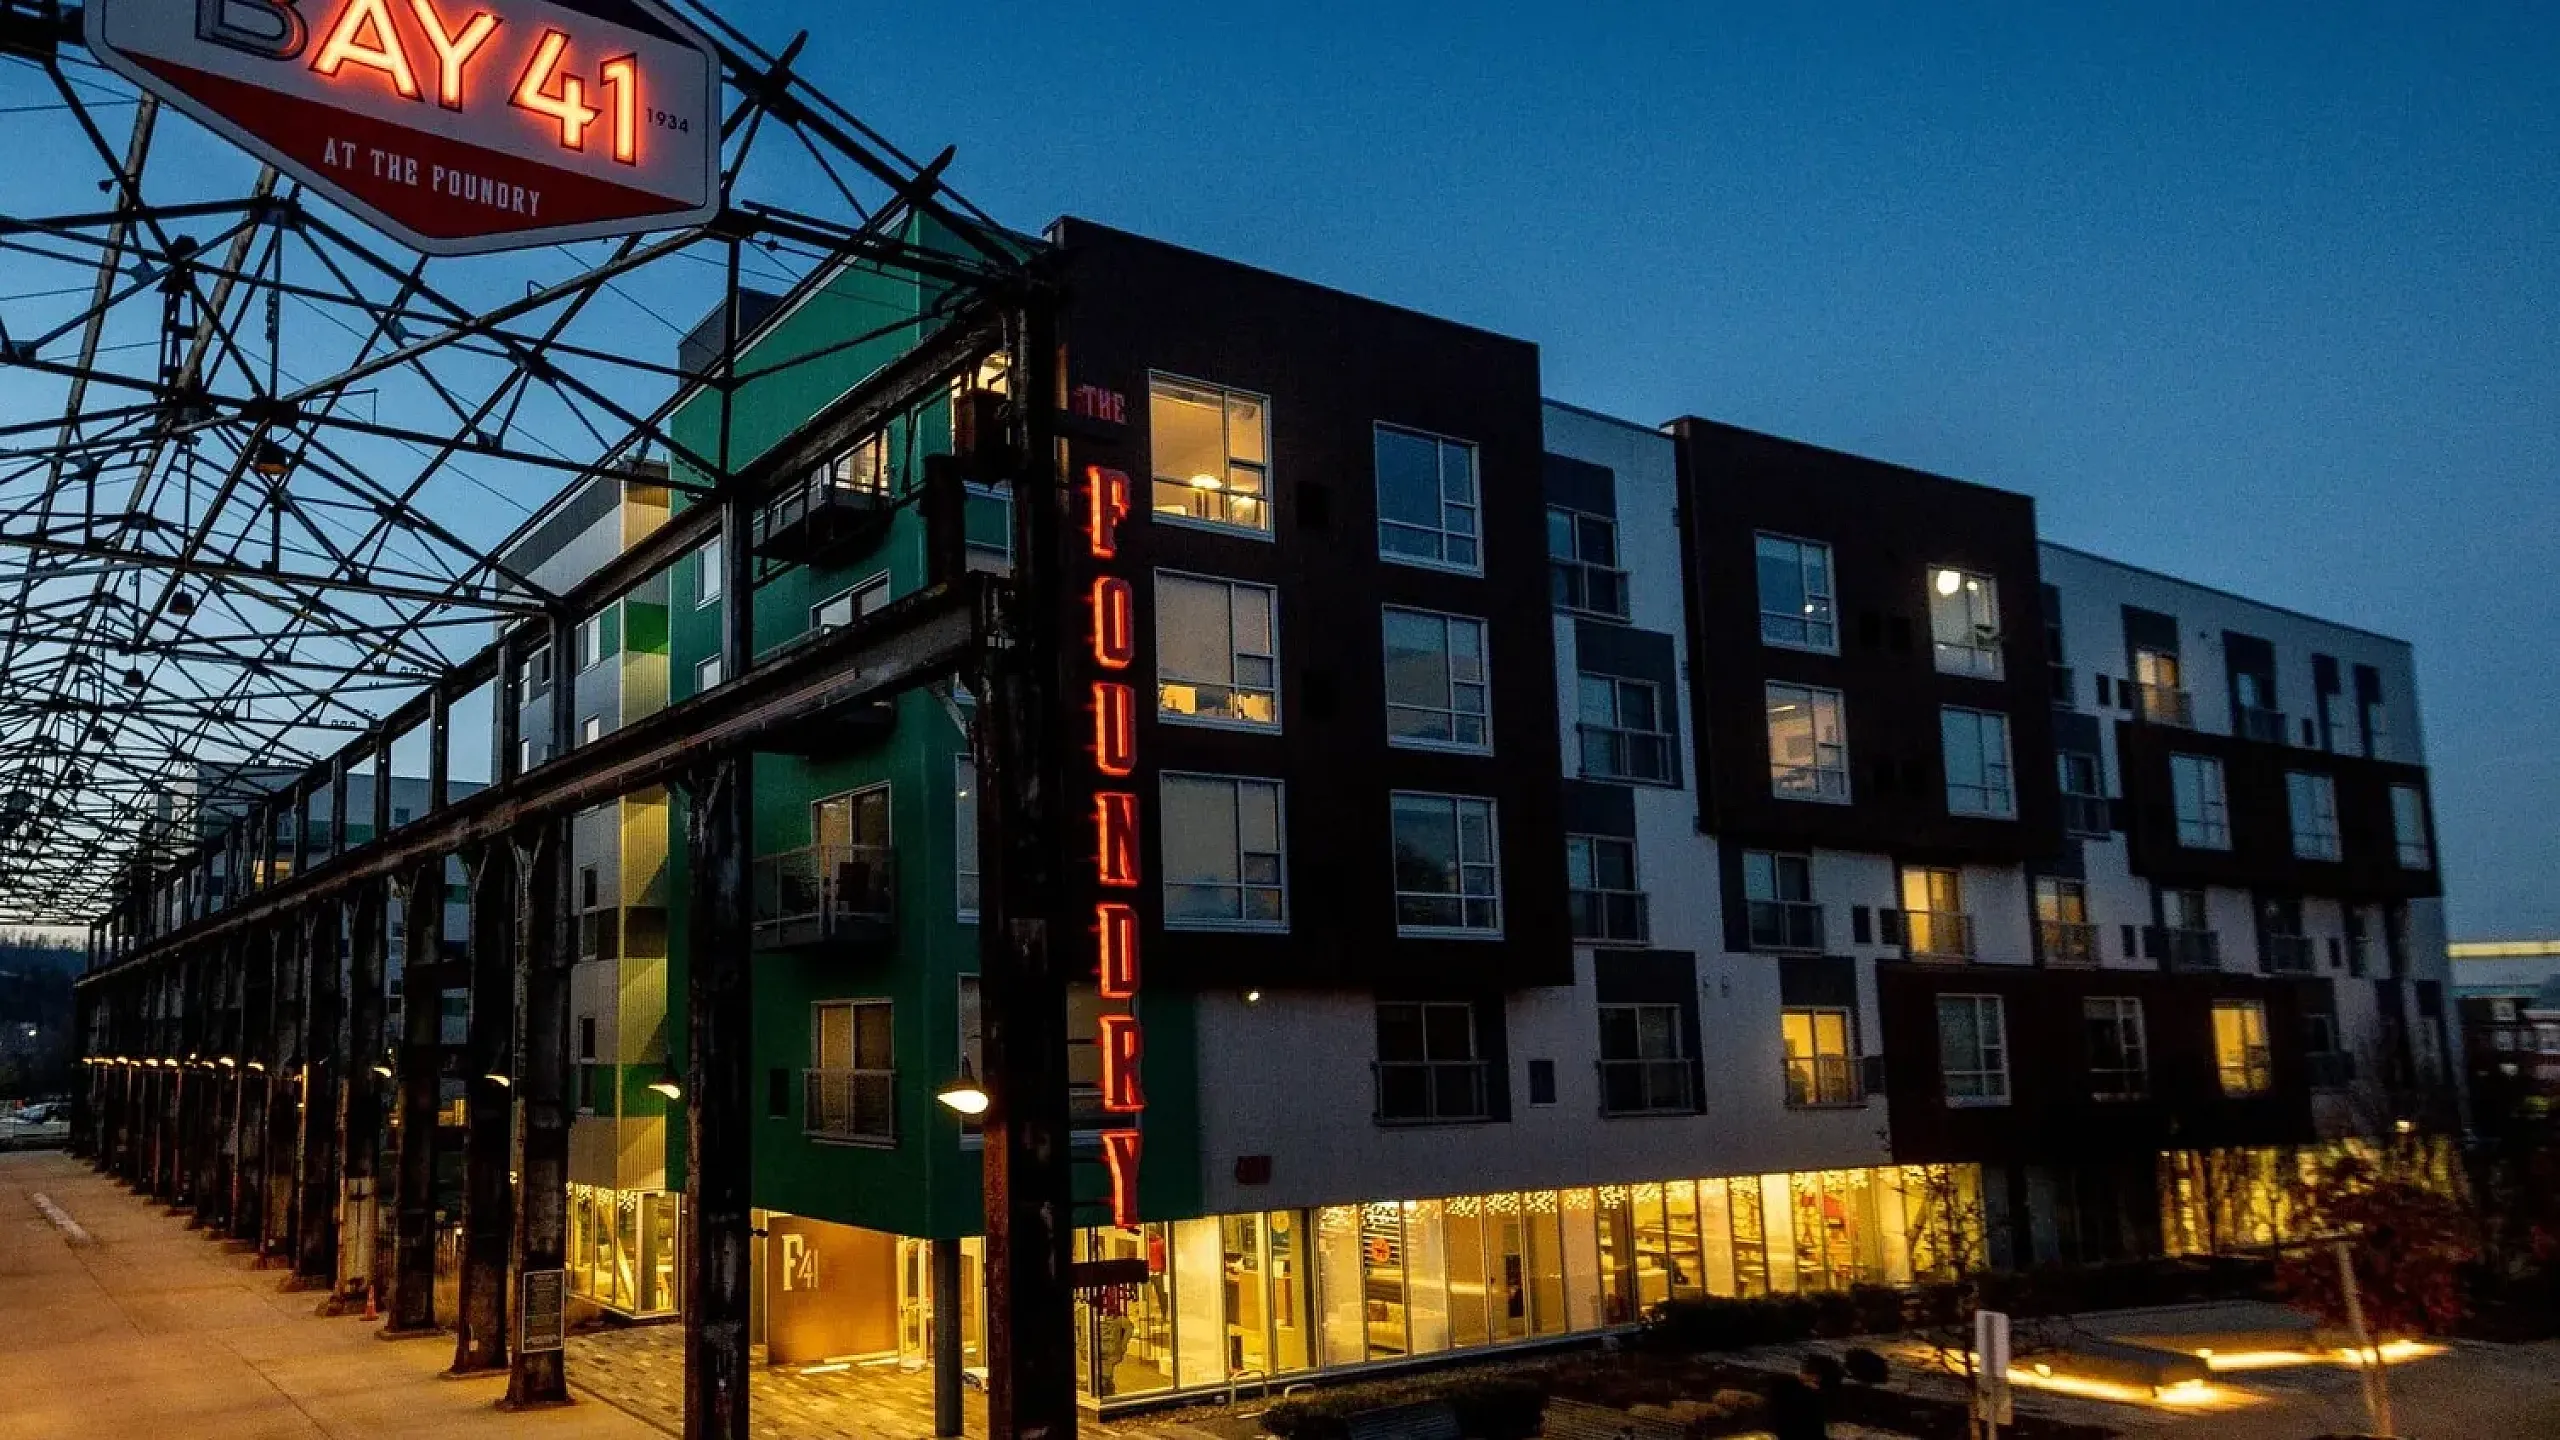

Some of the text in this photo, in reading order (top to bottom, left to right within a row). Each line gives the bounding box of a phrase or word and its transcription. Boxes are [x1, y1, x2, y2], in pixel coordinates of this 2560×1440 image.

[507, 28, 638, 168] 41
[647, 107, 690, 134] 1934
[323, 136, 540, 217] AT THE FOUNDRY
[1073, 384, 1126, 425] THE
[1087, 465, 1145, 1230] FOUNDRY
